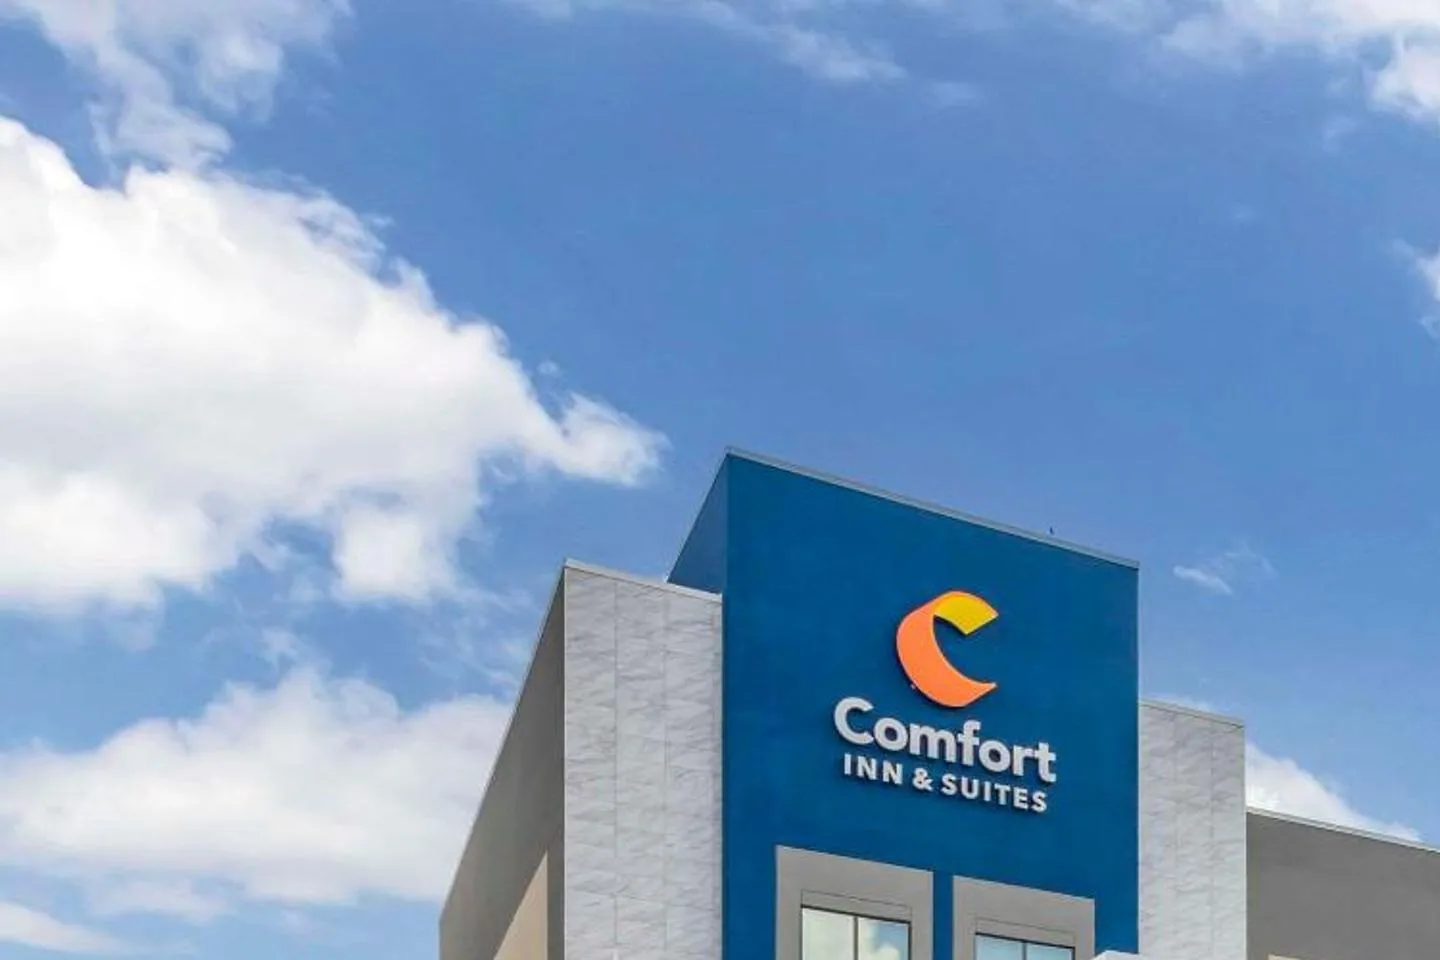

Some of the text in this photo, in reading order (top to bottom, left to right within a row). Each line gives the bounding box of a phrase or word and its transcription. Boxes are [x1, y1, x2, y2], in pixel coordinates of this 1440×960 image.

[834, 696, 1057, 783] Comfort
[843, 753, 1048, 814] INN & SUITES
